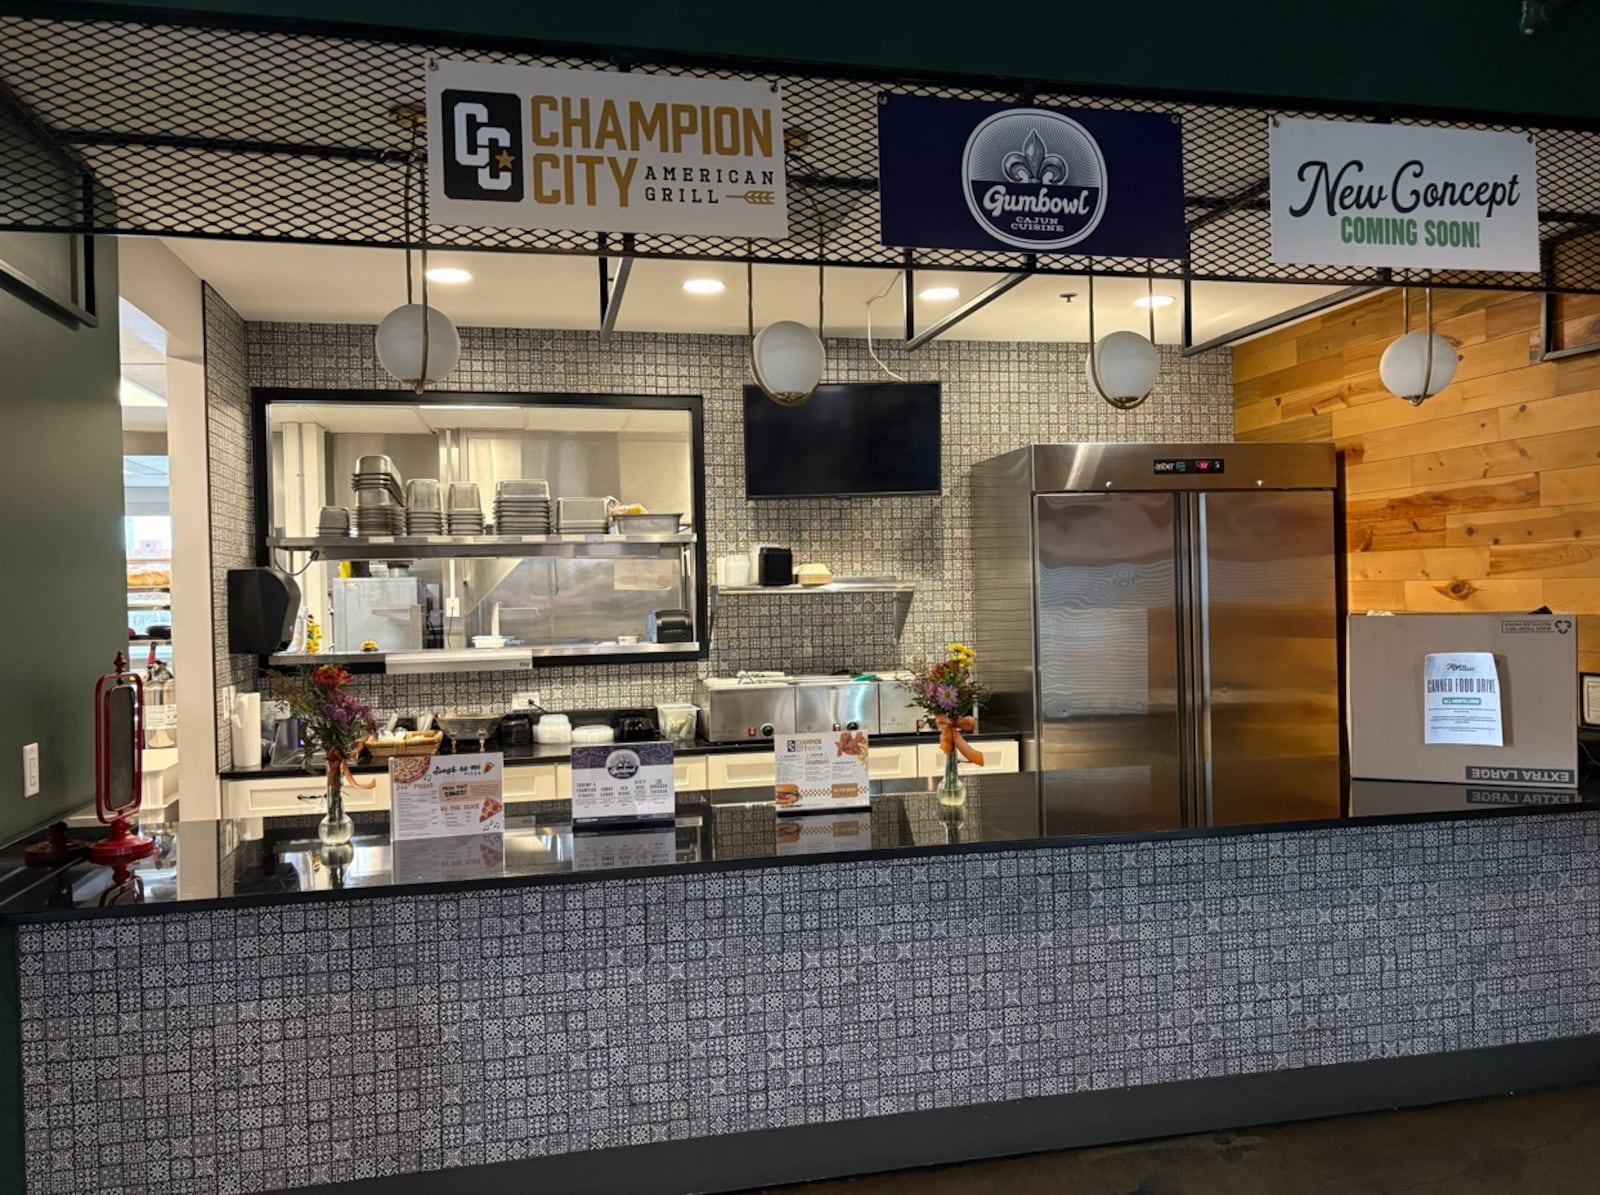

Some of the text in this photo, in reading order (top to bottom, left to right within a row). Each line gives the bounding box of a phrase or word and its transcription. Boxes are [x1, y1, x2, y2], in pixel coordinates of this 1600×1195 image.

[530, 95, 773, 158] CHAMPION
[532, 153, 638, 208] CITY
[645, 165, 774, 185] AMERICAN
[645, 187, 720, 204] GRILL
[1289, 160, 1521, 218] New Concept
[983, 185, 1090, 217] Gumbowl
[1010, 223, 1065, 232] CUISINE
[1015, 215, 1059, 225] CAJUN
[1340, 215, 1481, 249] COMING SOON!
[1427, 678, 1496, 694] CANNED FOOD DRIVE
[1471, 768, 1569, 782] EXTRA LARGE
